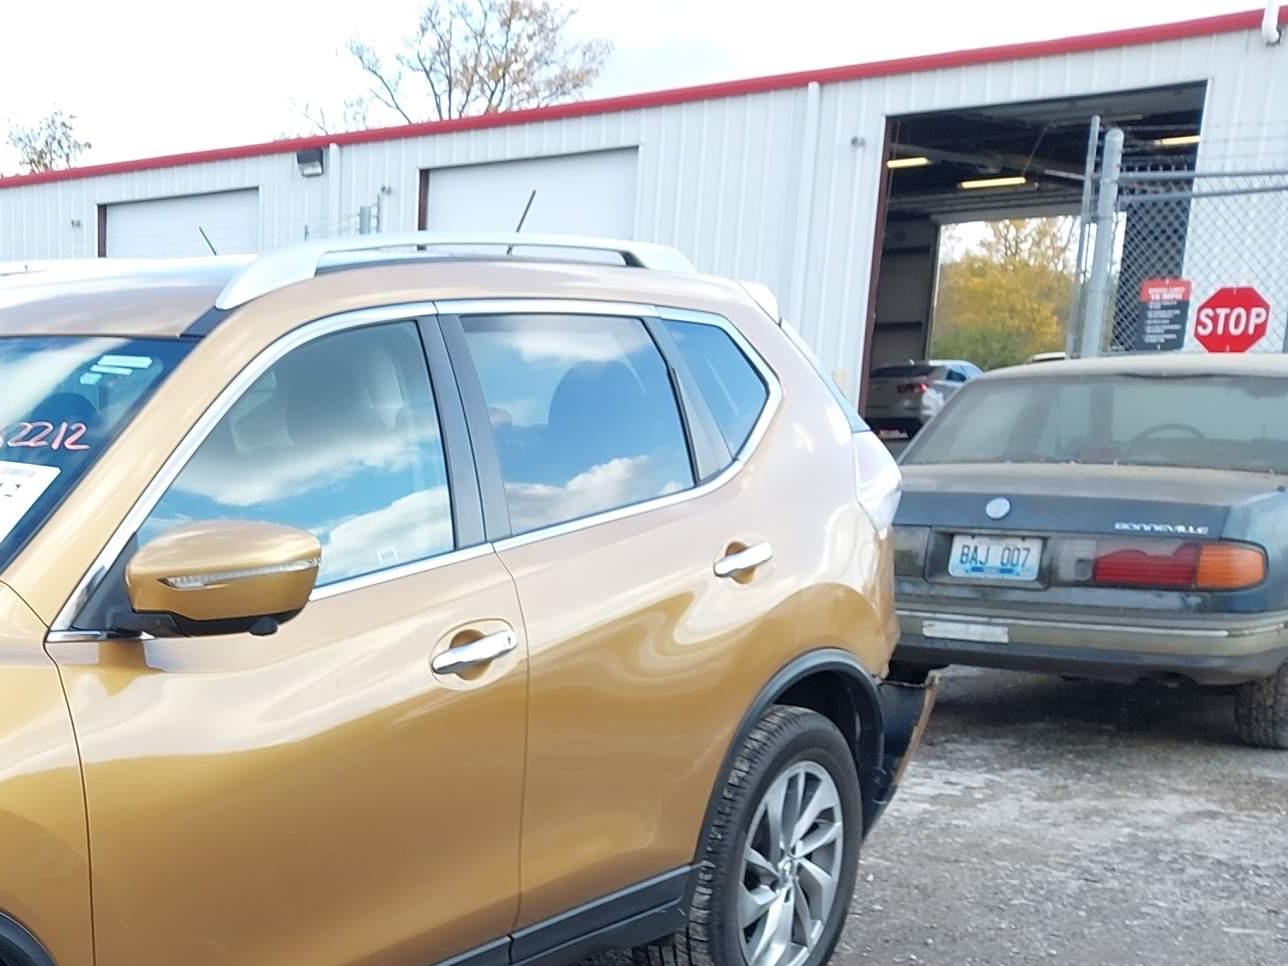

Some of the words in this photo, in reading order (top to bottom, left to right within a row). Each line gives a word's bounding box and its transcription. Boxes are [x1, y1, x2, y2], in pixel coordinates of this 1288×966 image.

[1197, 307, 1267, 336] STOP
[959, 544, 991, 566] BAJ
[1000, 546, 1032, 568] 007
